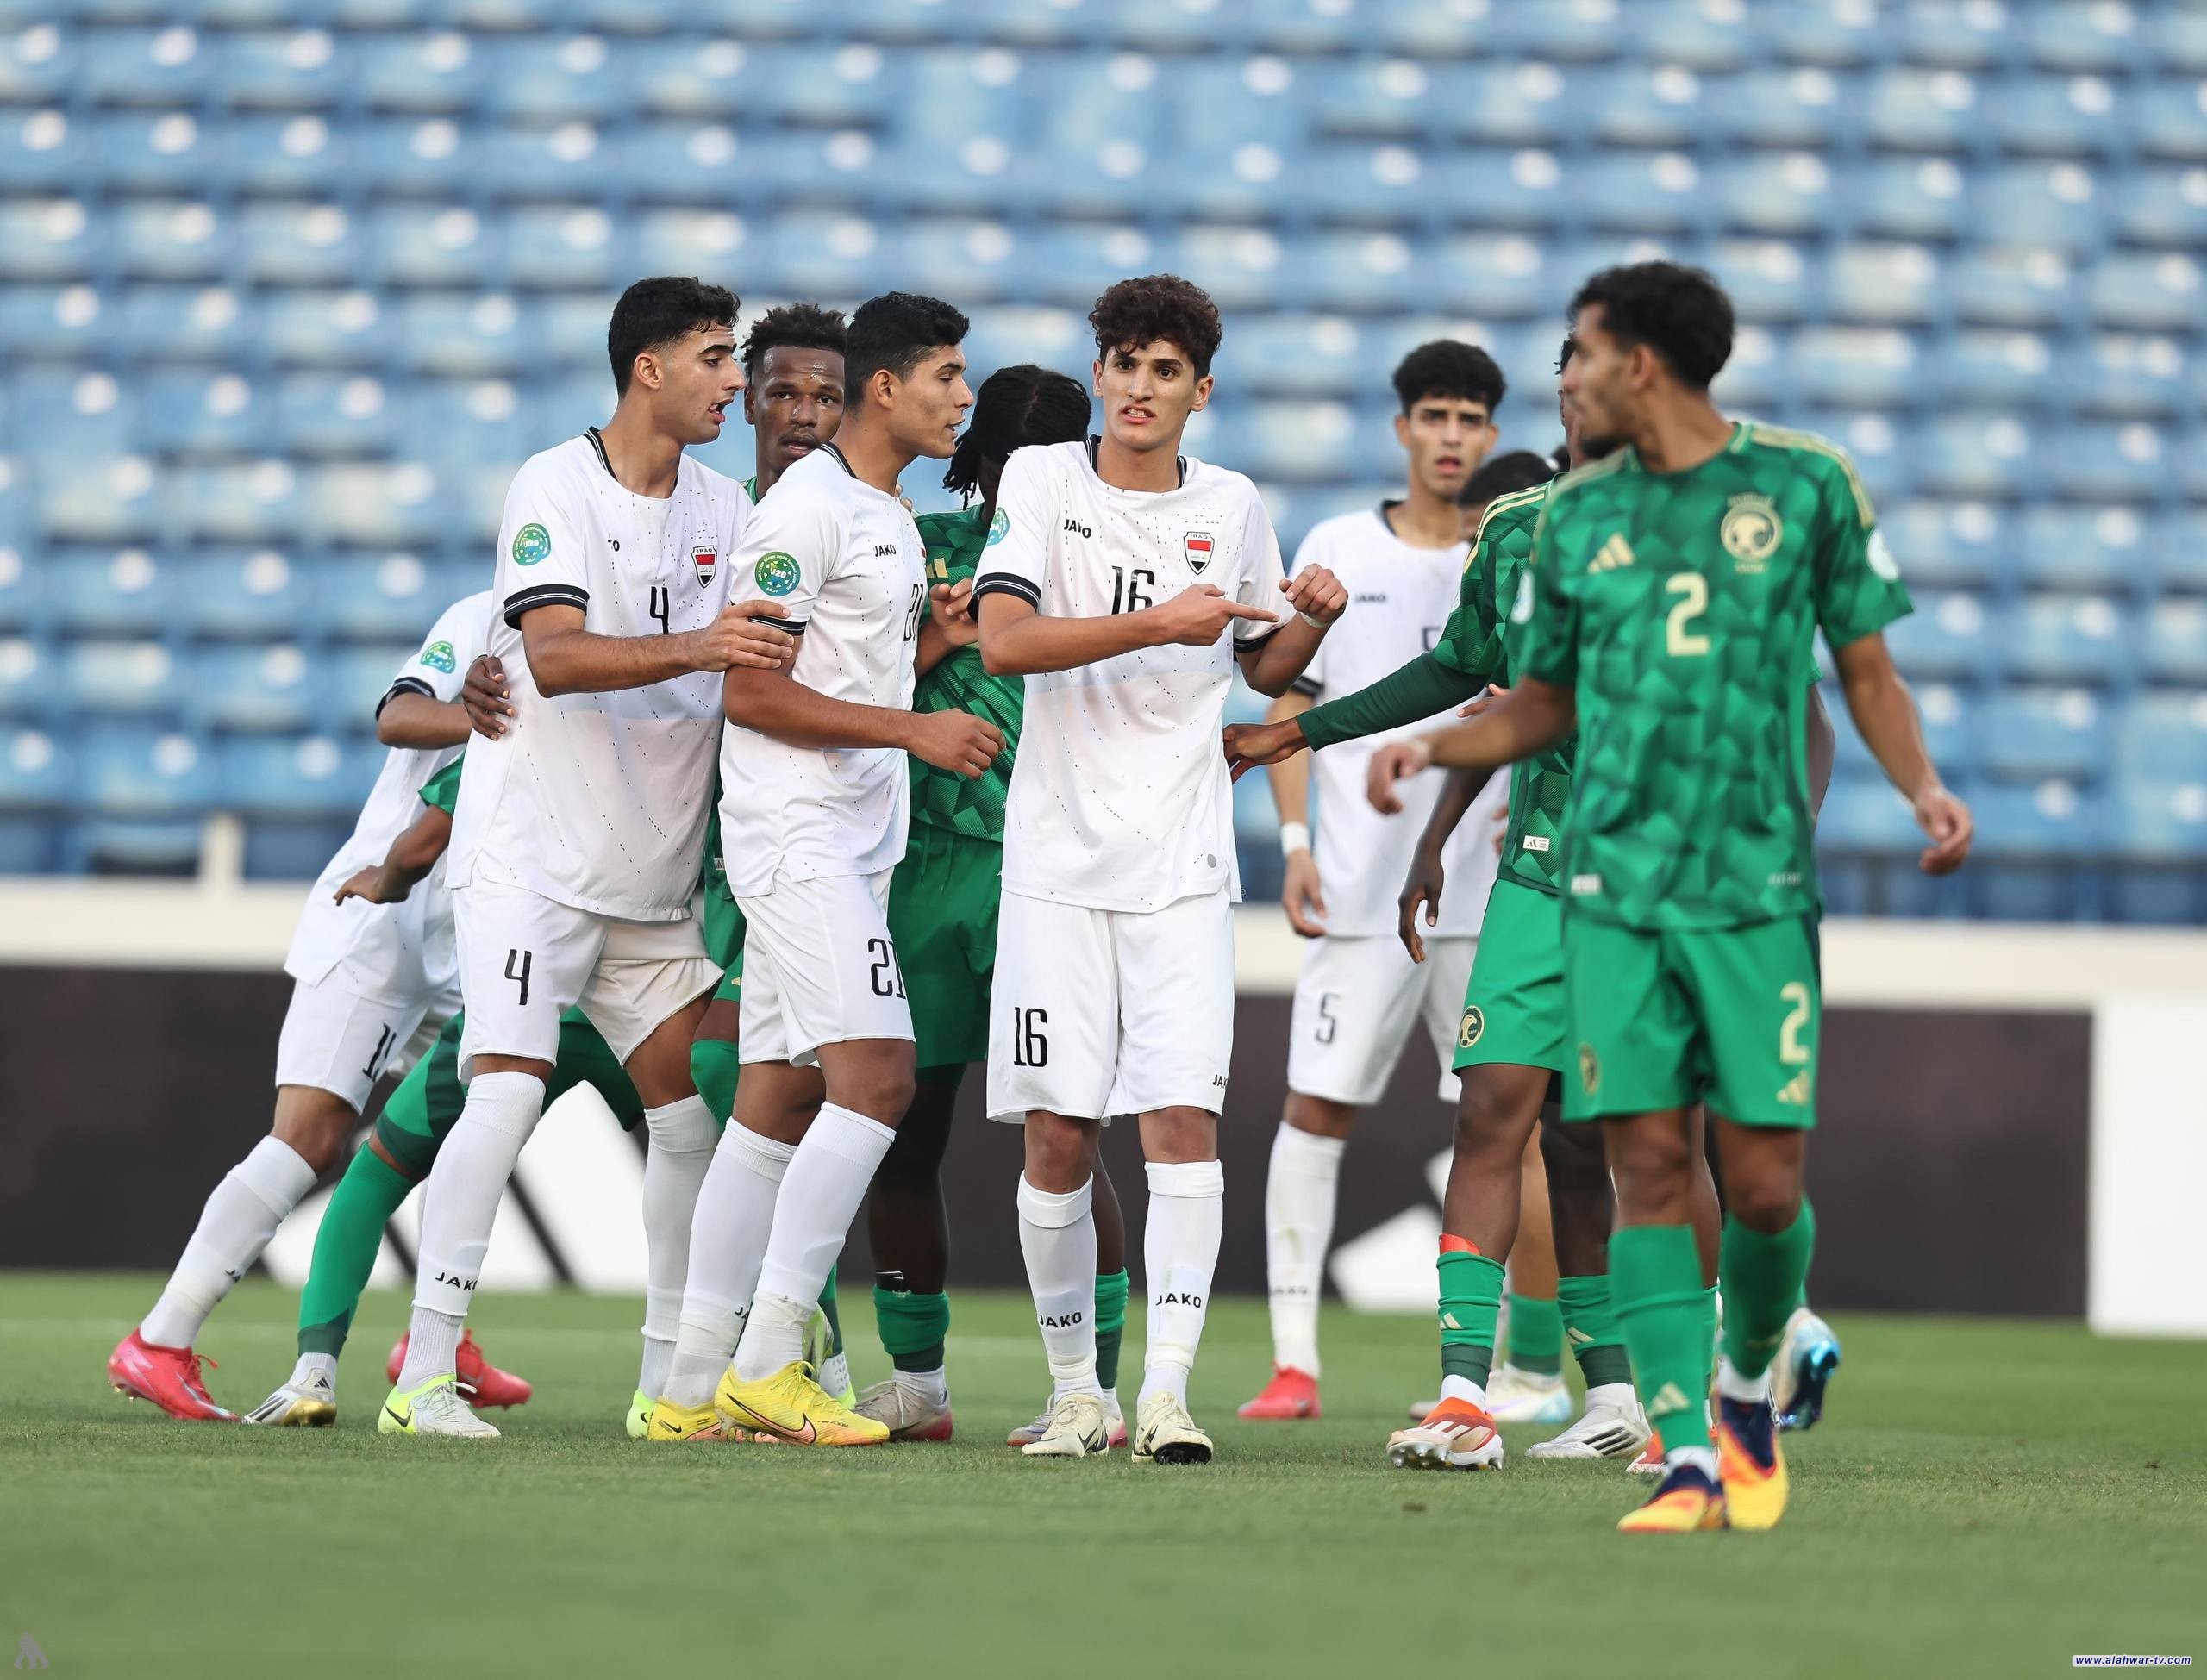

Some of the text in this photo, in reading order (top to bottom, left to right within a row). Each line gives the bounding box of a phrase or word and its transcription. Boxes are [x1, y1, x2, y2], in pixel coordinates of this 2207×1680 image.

[770, 567, 787, 578] U20
[874, 544, 897, 558] JAKO
[650, 586, 669, 635] 4
[903, 583, 923, 642] 21
[1111, 565, 1155, 615] 16
[1666, 571, 1710, 657] 2
[504, 948, 533, 1006] 4
[867, 938, 907, 1000] 21
[1014, 1006, 1048, 1068] 16
[1315, 992, 1341, 1045] 5
[1779, 982, 1810, 1065] 2
[1040, 1311, 1082, 1328] JAKO
[1156, 1293, 1202, 1308] JAKO
